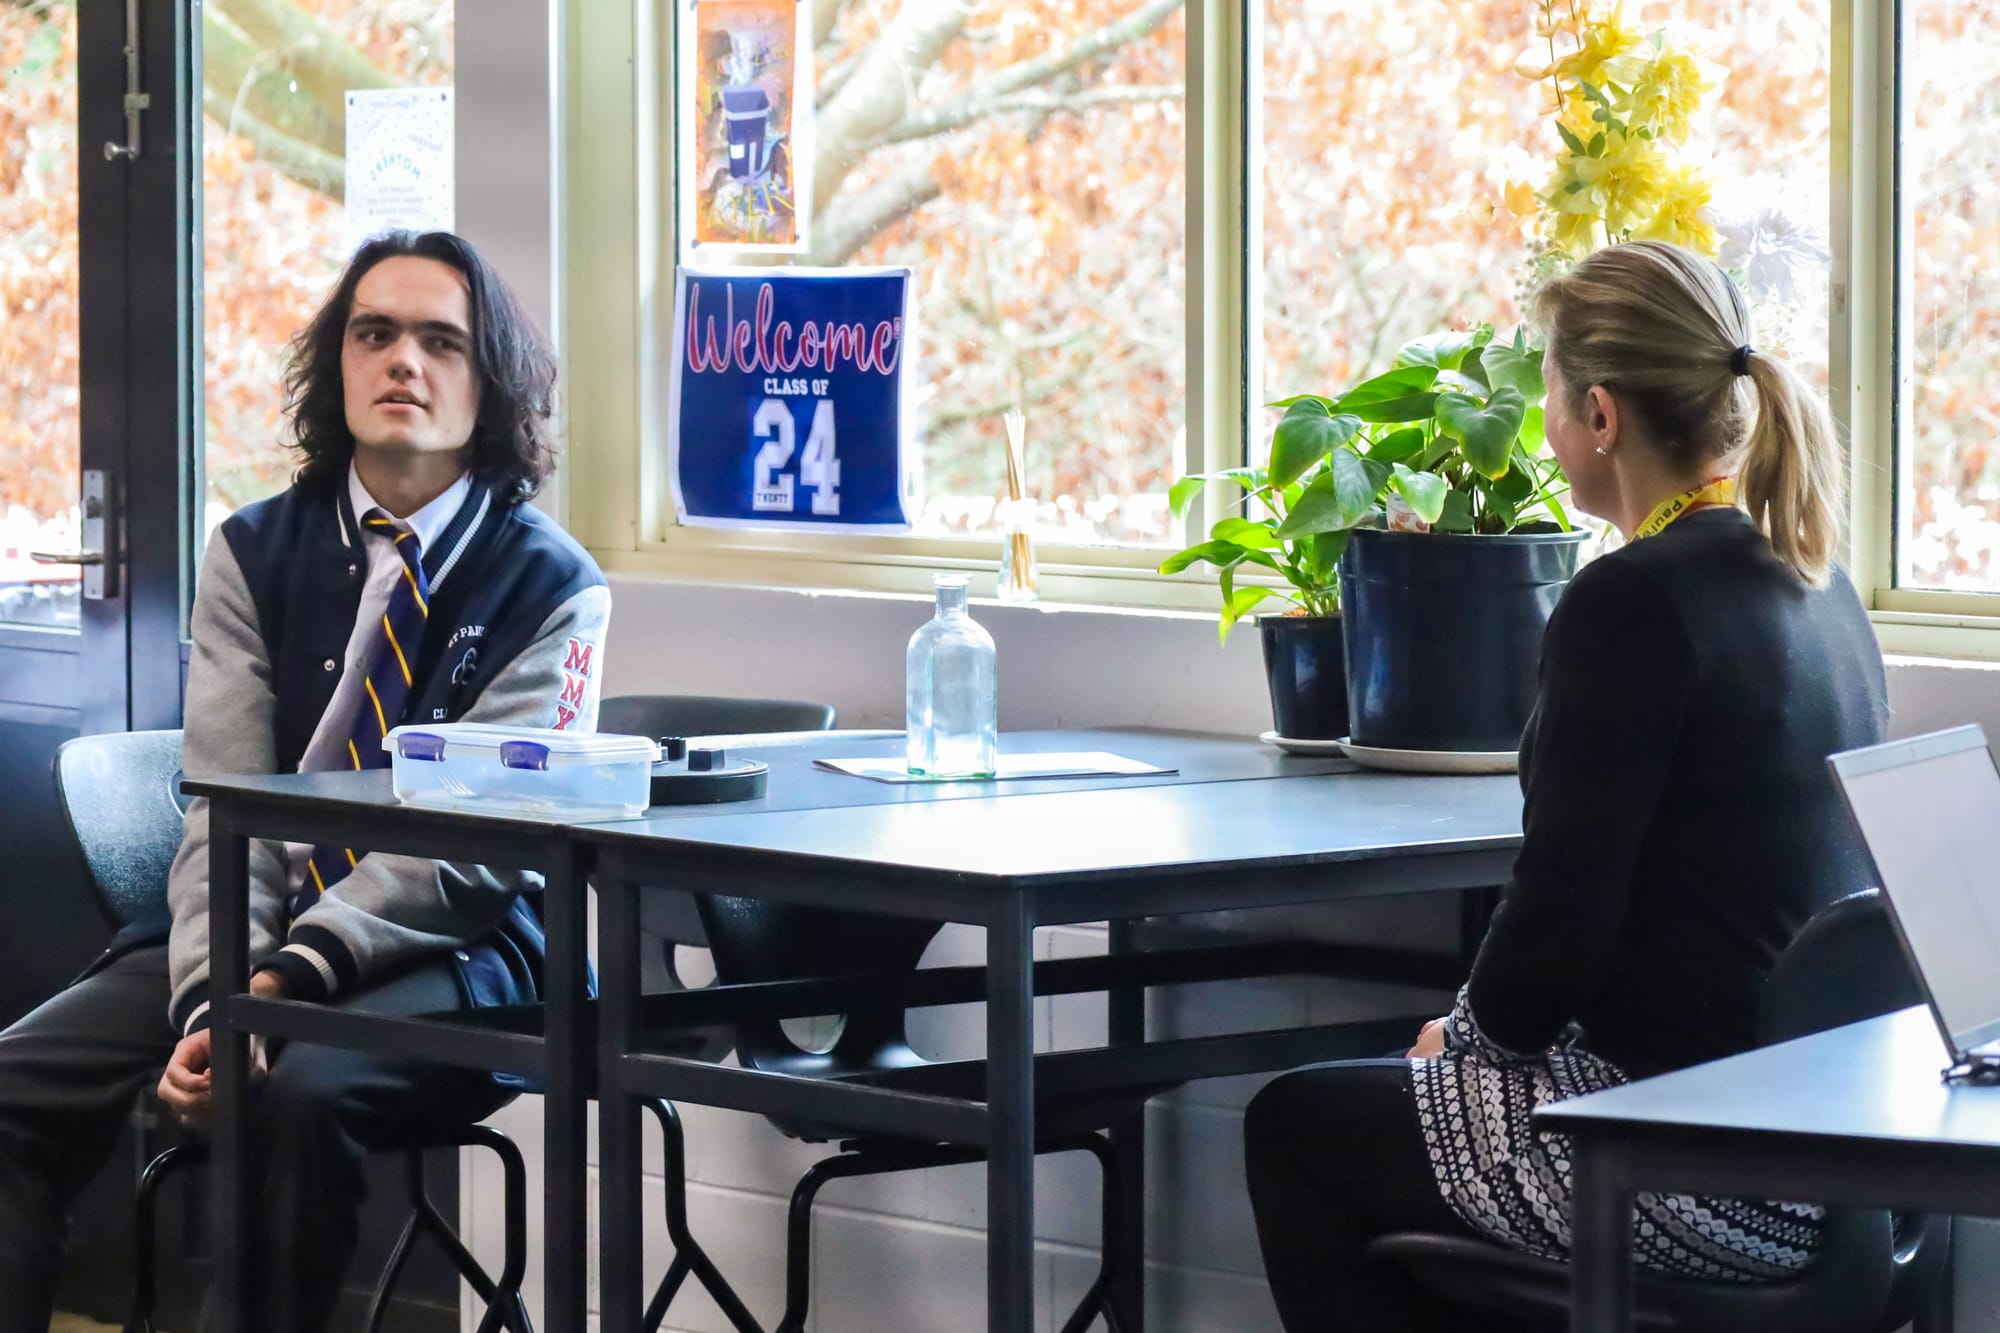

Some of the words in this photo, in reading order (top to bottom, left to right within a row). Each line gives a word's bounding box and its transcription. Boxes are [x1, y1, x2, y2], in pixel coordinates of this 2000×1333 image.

[687, 282, 901, 376] Welcome
[763, 378, 808, 395] CLASS
[812, 379, 829, 395] OF
[752, 398, 841, 515] 24
[757, 493, 789, 504] TWENTY
[433, 708, 448, 720] CL
